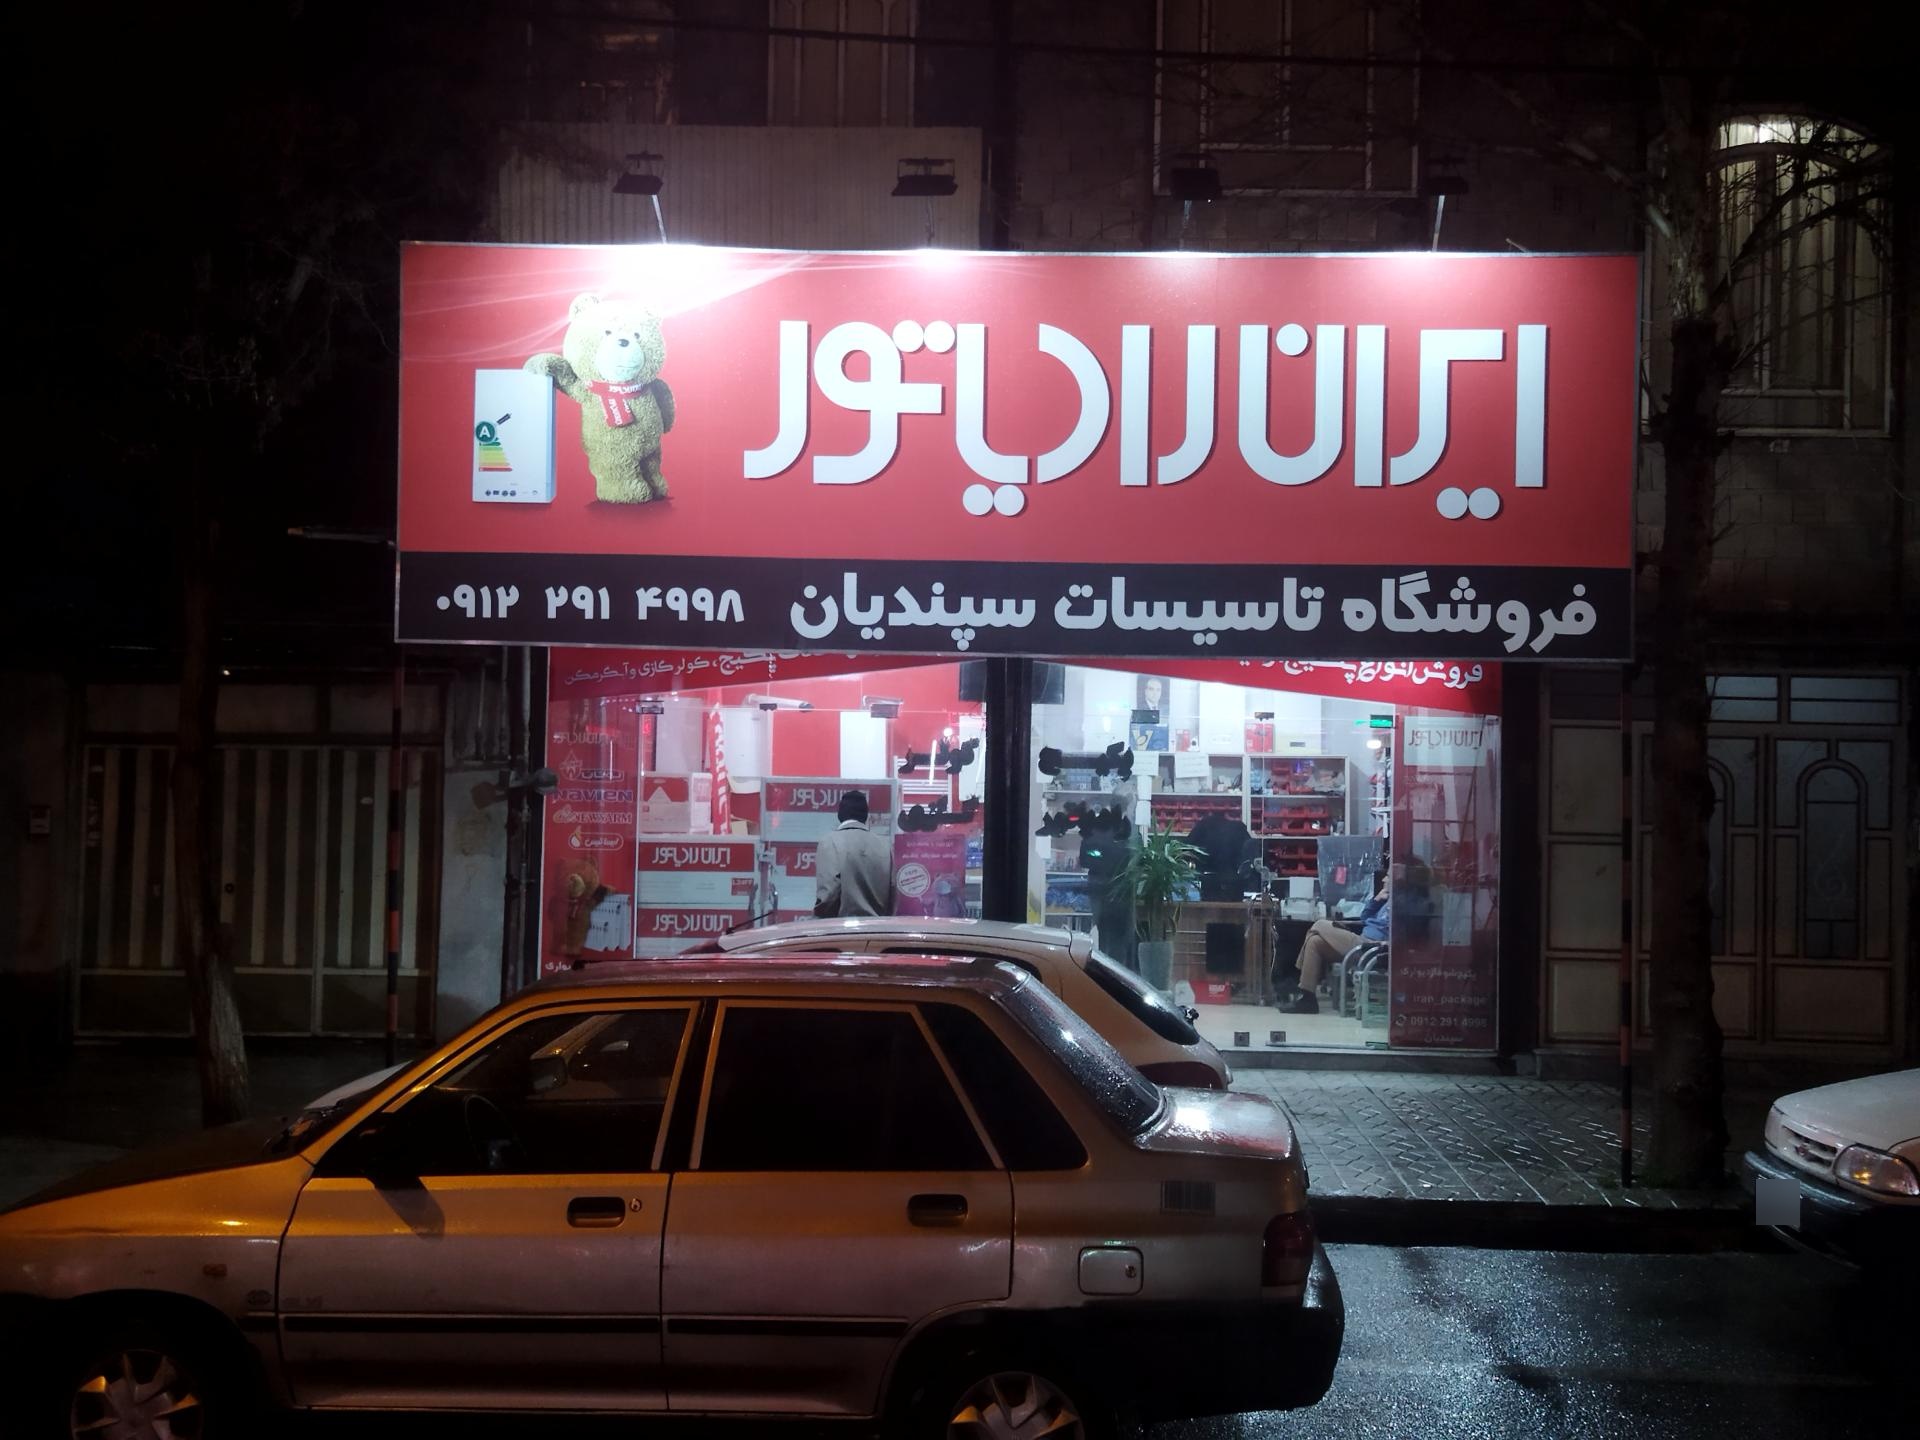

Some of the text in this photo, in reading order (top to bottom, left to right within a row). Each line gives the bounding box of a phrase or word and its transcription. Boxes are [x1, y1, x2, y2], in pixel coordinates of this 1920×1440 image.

[743, 319, 1546, 519] ایران رادیاتور
[437, 585, 744, 622] ۰۹۱۲ ۲۹۱ ۴۹۹۸
[790, 571, 1596, 652] فروشگاه تاسیسات سپندیان
[1411, 661, 1482, 689] فروش
[652, 847, 731, 868] ایران رادیاتور
[653, 914, 733, 935] ایران رادیاتور
[1410, 1016, 1438, 1026] 0912
[1440, 1017, 1457, 1026] 291
